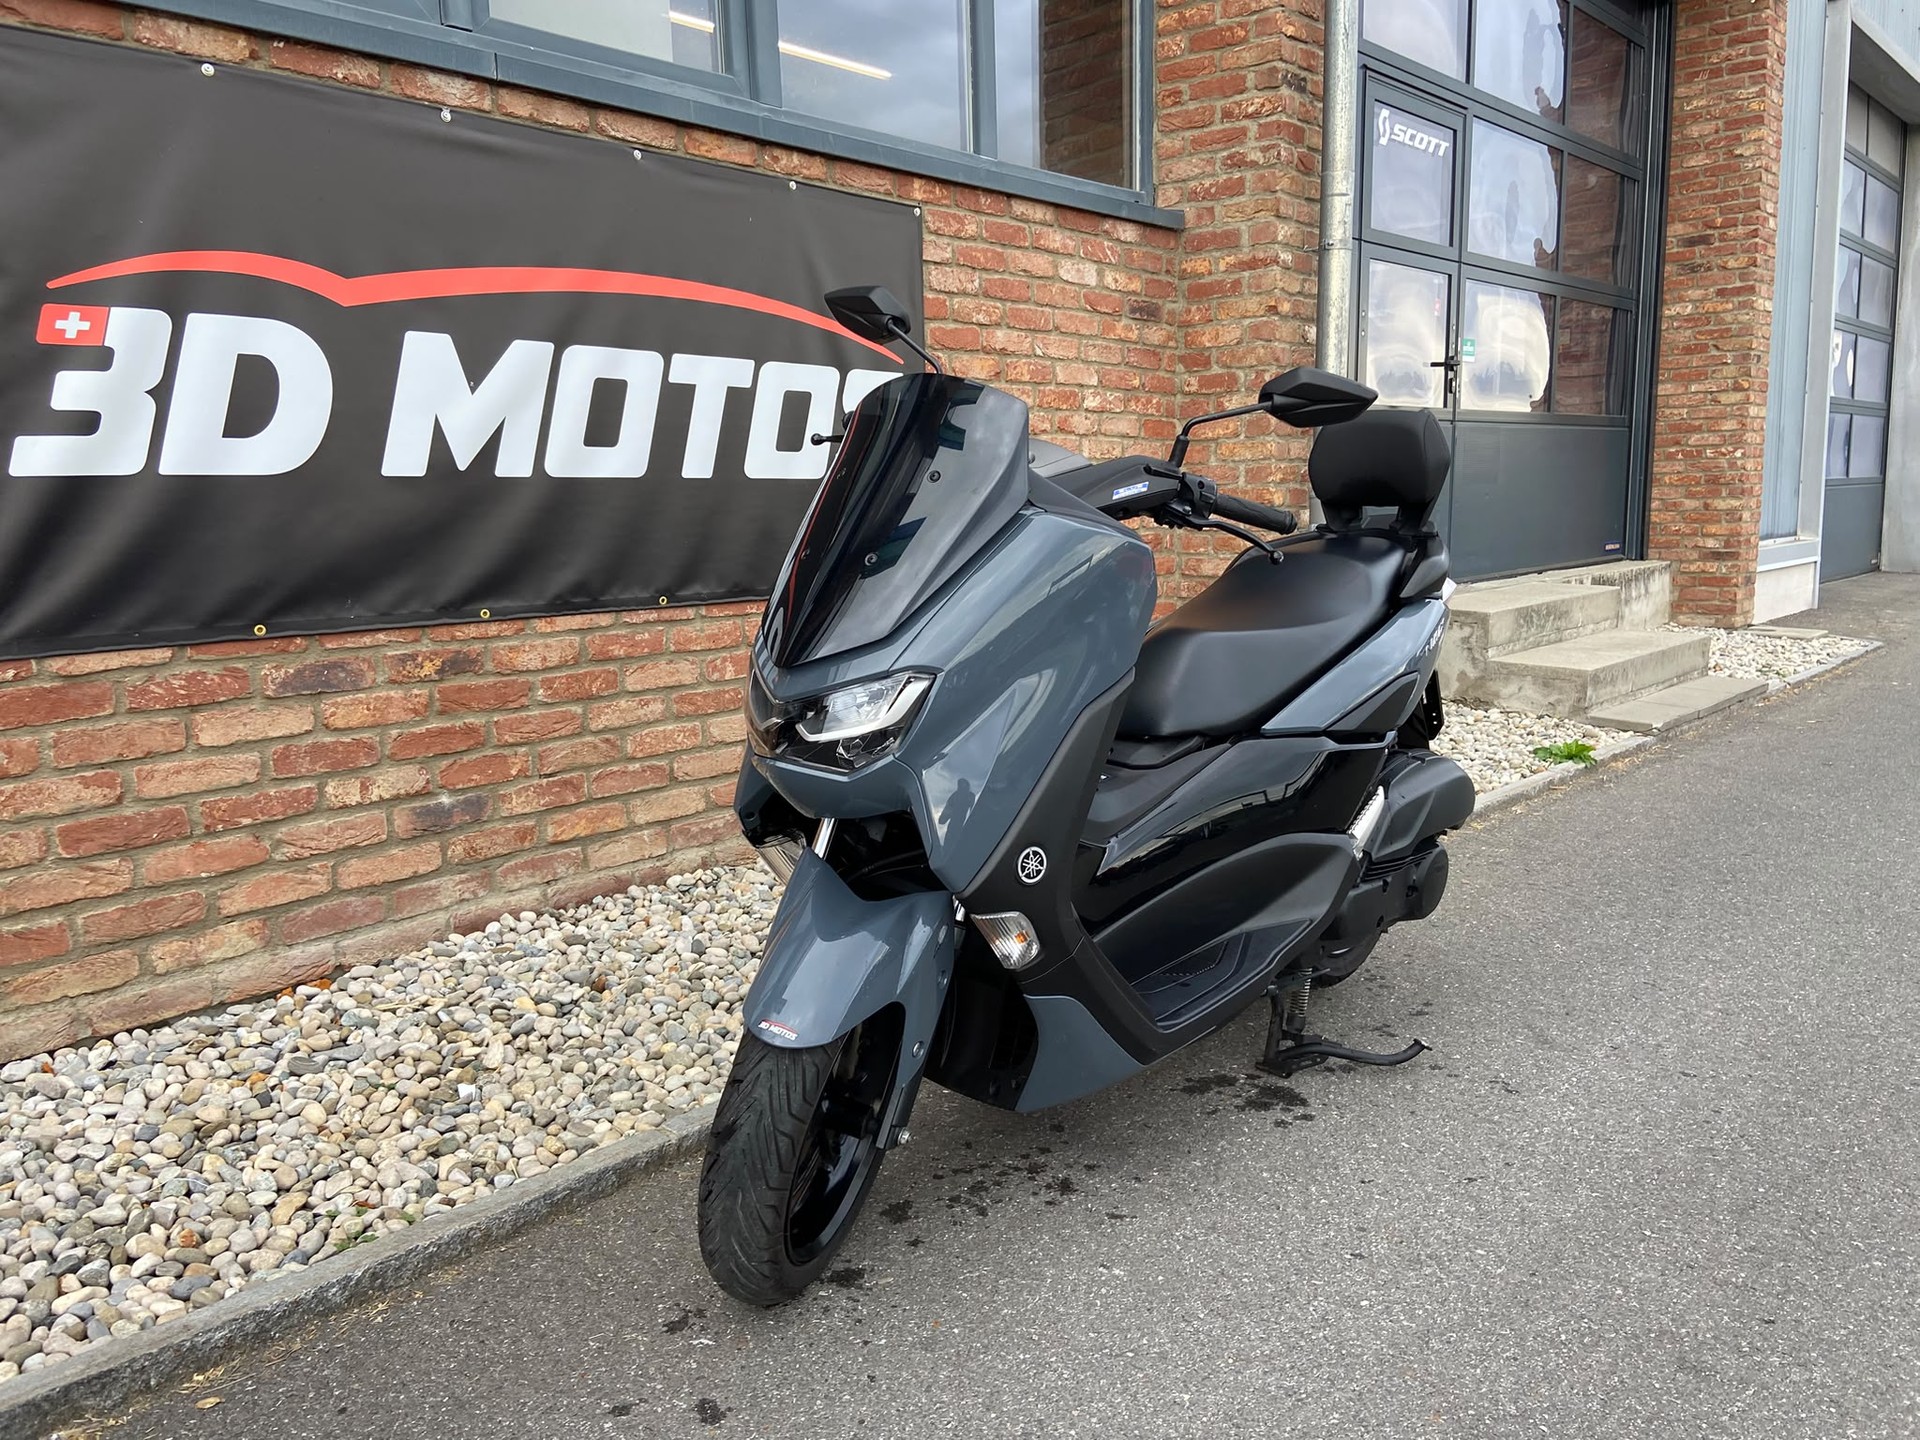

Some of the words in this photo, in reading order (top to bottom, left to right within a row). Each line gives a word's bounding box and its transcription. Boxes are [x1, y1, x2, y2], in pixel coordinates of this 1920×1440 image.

[1391, 123, 1450, 157] SCOTT
[8, 303, 333, 478] 3D
[768, 1024, 799, 1041] MOTOS
